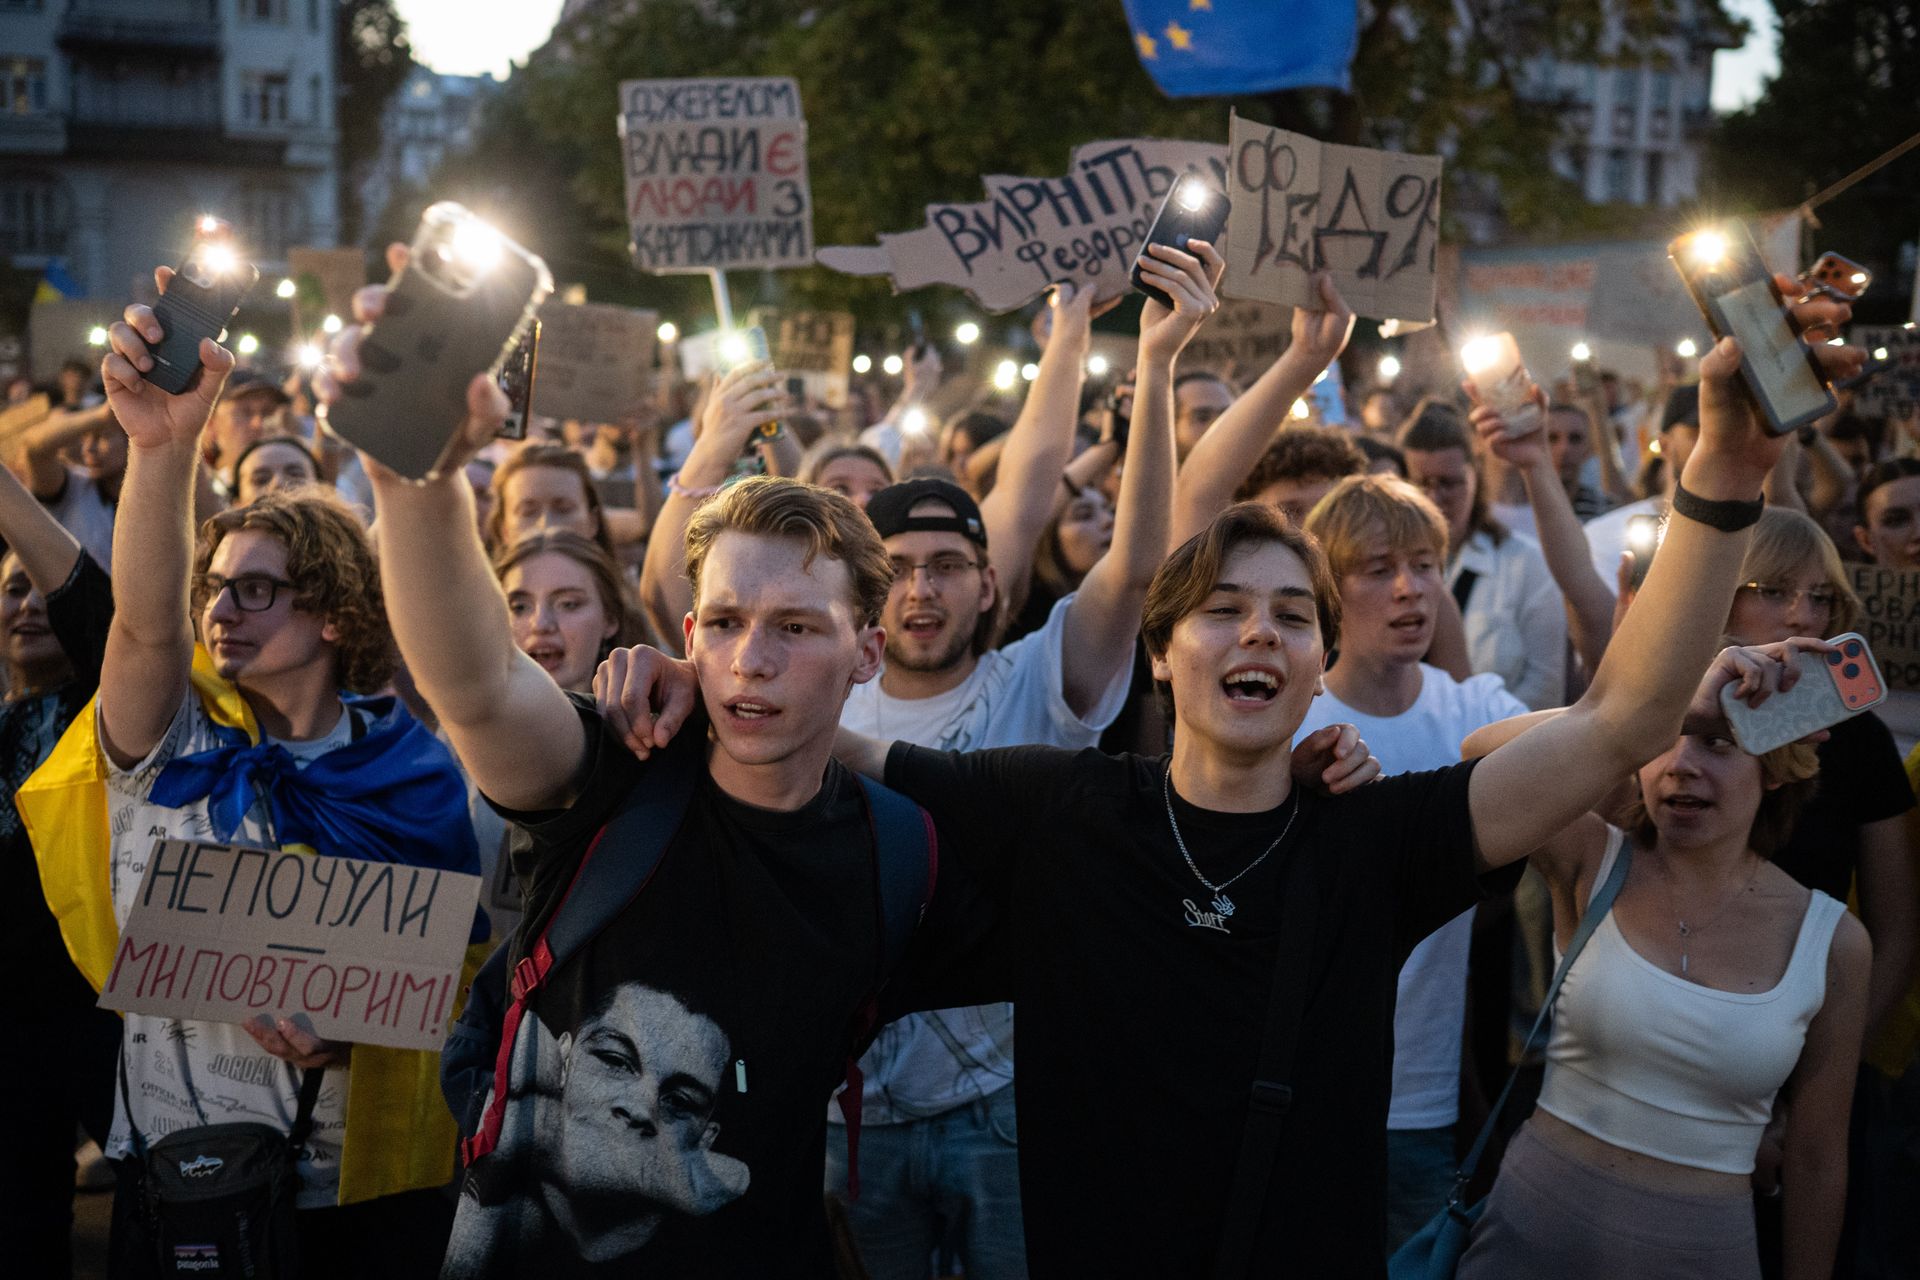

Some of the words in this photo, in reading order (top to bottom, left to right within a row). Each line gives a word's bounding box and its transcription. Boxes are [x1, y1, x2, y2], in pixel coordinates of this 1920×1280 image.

[627, 83, 796, 122] ДЖЕРЕЛОМ
[629, 127, 760, 177] ВЛАДИ
[766, 133, 799, 175] Є
[632, 177, 757, 217] ЛЮДИ
[773, 179, 804, 217] З
[635, 219, 806, 265] КАРТОНКАМИ
[206, 1053, 279, 1087] JORDAN
[177, 1259, 219, 1272] patagonia
